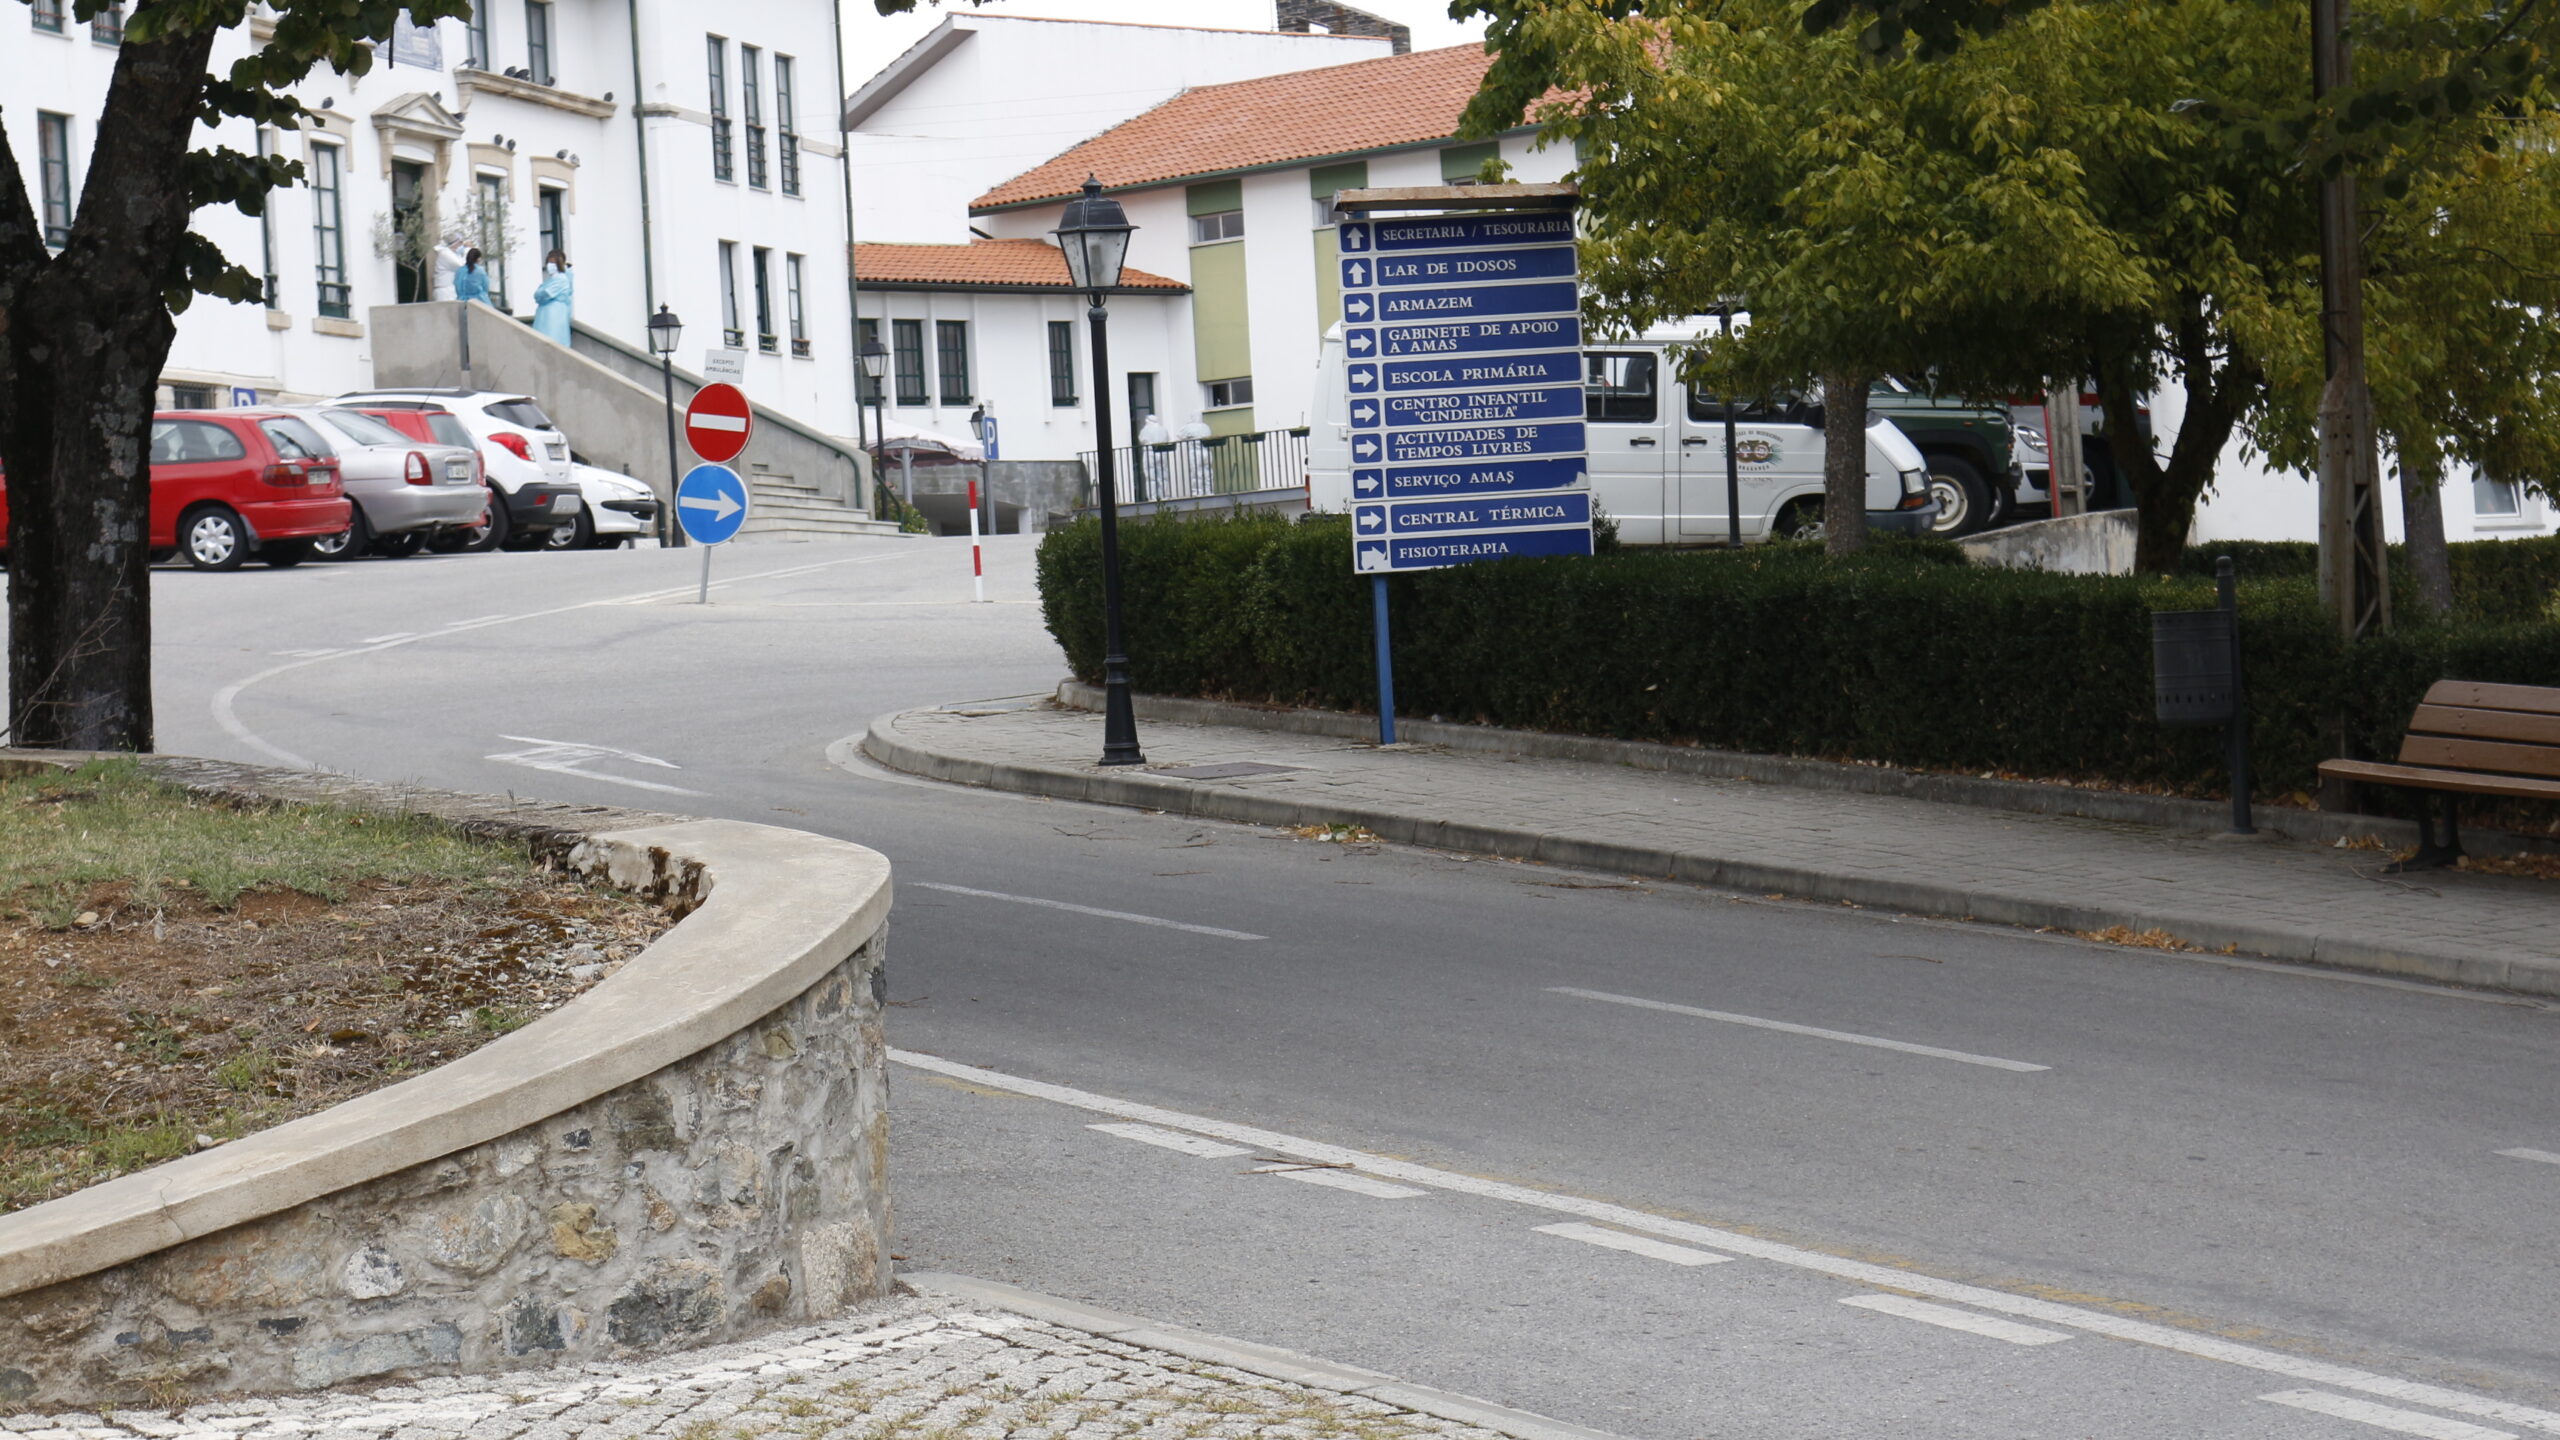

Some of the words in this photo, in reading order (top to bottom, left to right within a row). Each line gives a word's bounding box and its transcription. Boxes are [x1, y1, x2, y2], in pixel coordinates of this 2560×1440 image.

[1383, 227, 1465, 241] SECRETARIA
[1472, 225, 1476, 237] /
[1484, 220, 1571, 236] TESOURARIA
[1385, 264, 1418, 277] LAR
[1427, 263, 1448, 274] DE
[1457, 259, 1517, 273] IDOSOS
[1387, 297, 1473, 312] ARMAZEM
[1389, 326, 1470, 340] GABINETE
[1480, 324, 1501, 336] DE
[1509, 321, 1559, 335] APOIO
[1390, 342, 1400, 353] A
[1411, 339, 1457, 352] AMAS
[1391, 368, 1454, 384] ESCOLA
[1463, 363, 1547, 380] PRIMÁRIA
[1392, 396, 1460, 411] CENTRO
[1469, 392, 1547, 406] INFANTIL
[1416, 406, 1517, 422] "CINDERELA"
[986, 421, 996, 456] P
[1395, 428, 1505, 445] ACTIVIDADES
[1516, 427, 1538, 438] DE
[1396, 445, 1462, 460] TEMPOS
[1473, 441, 1531, 455] LIVRES
[1395, 474, 1460, 488] SERVIÇO
[1400, 510, 1479, 526] CENTRAL
[1489, 505, 1566, 521] TÉRMICA
[1400, 542, 1509, 559] FISIOTERAPIA
